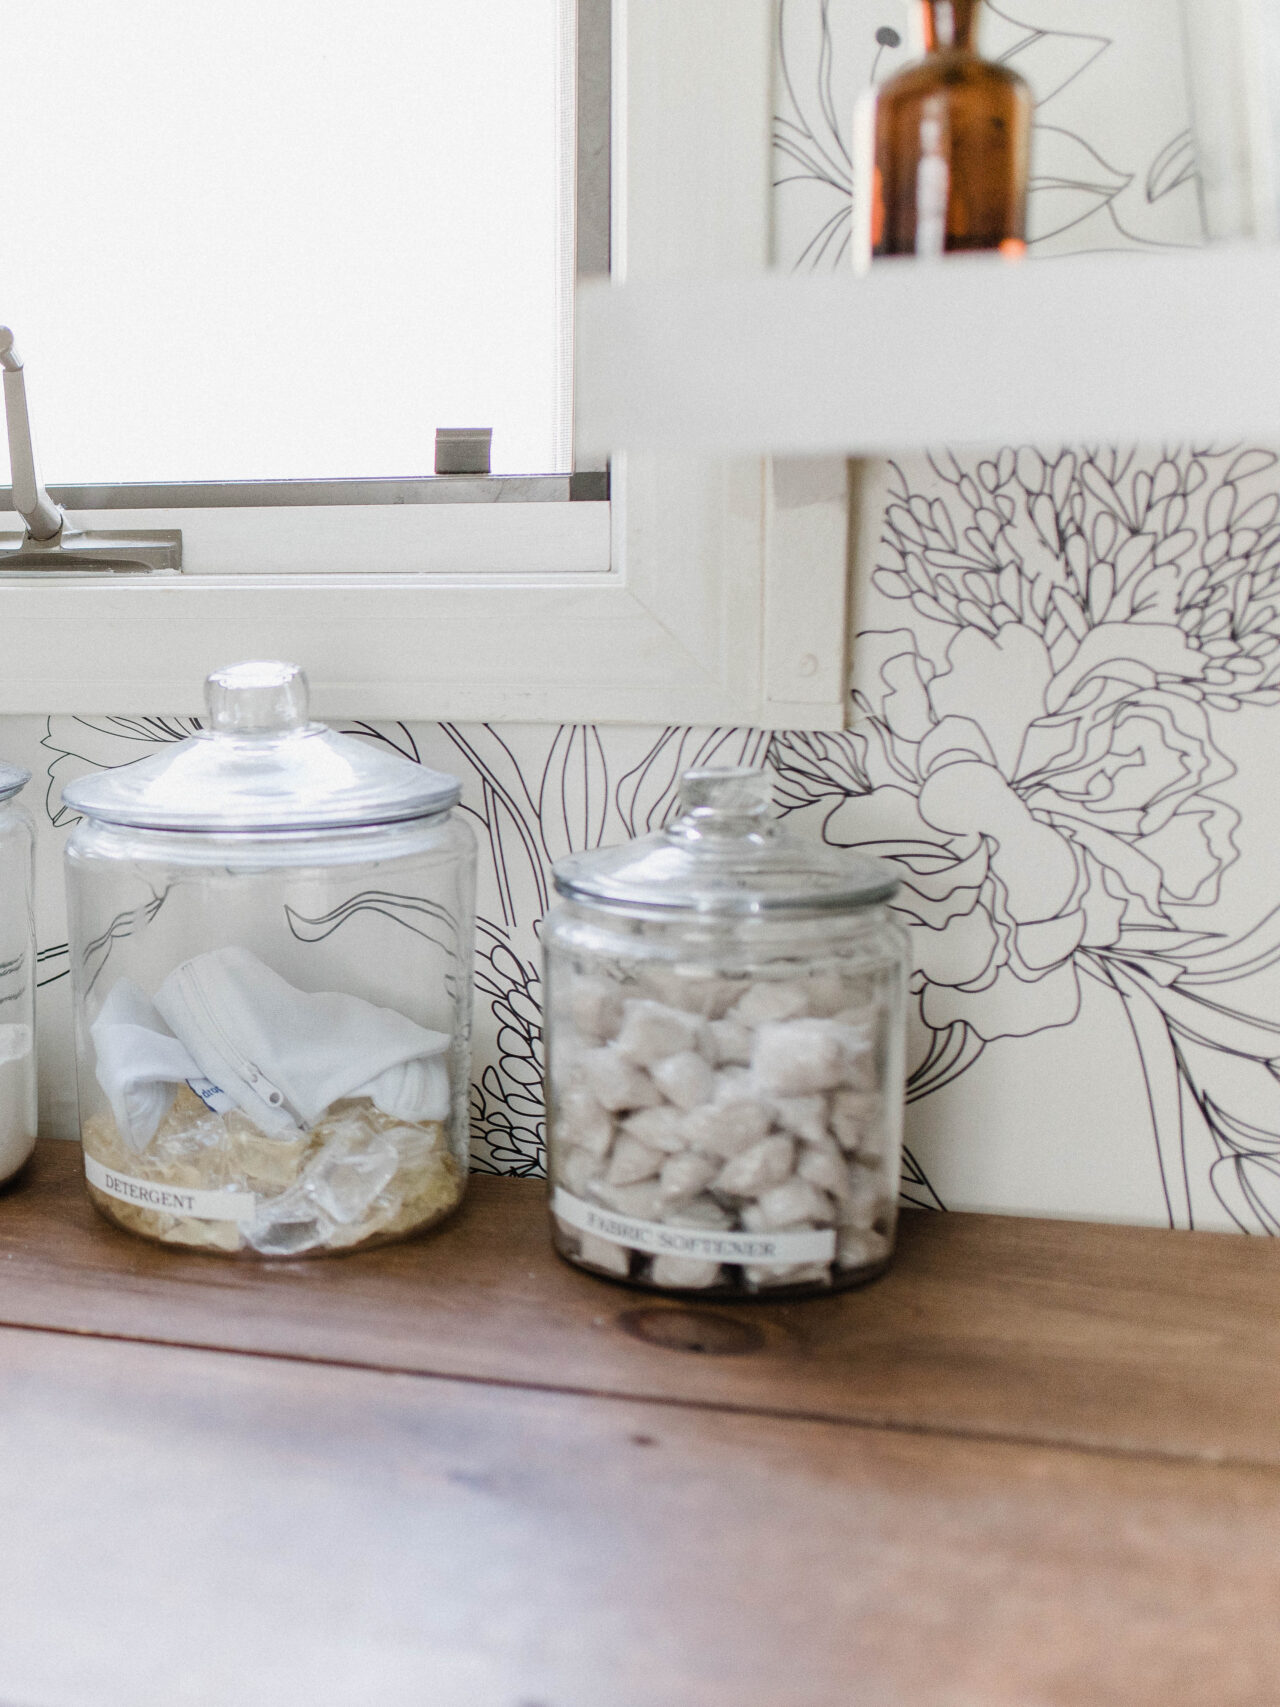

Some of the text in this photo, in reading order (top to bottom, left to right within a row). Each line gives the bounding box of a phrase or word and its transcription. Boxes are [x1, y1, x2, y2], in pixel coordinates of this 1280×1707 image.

[105, 1173, 195, 1210] DETERGENT
[587, 1211, 777, 1258] FABRIC SOFTENER
